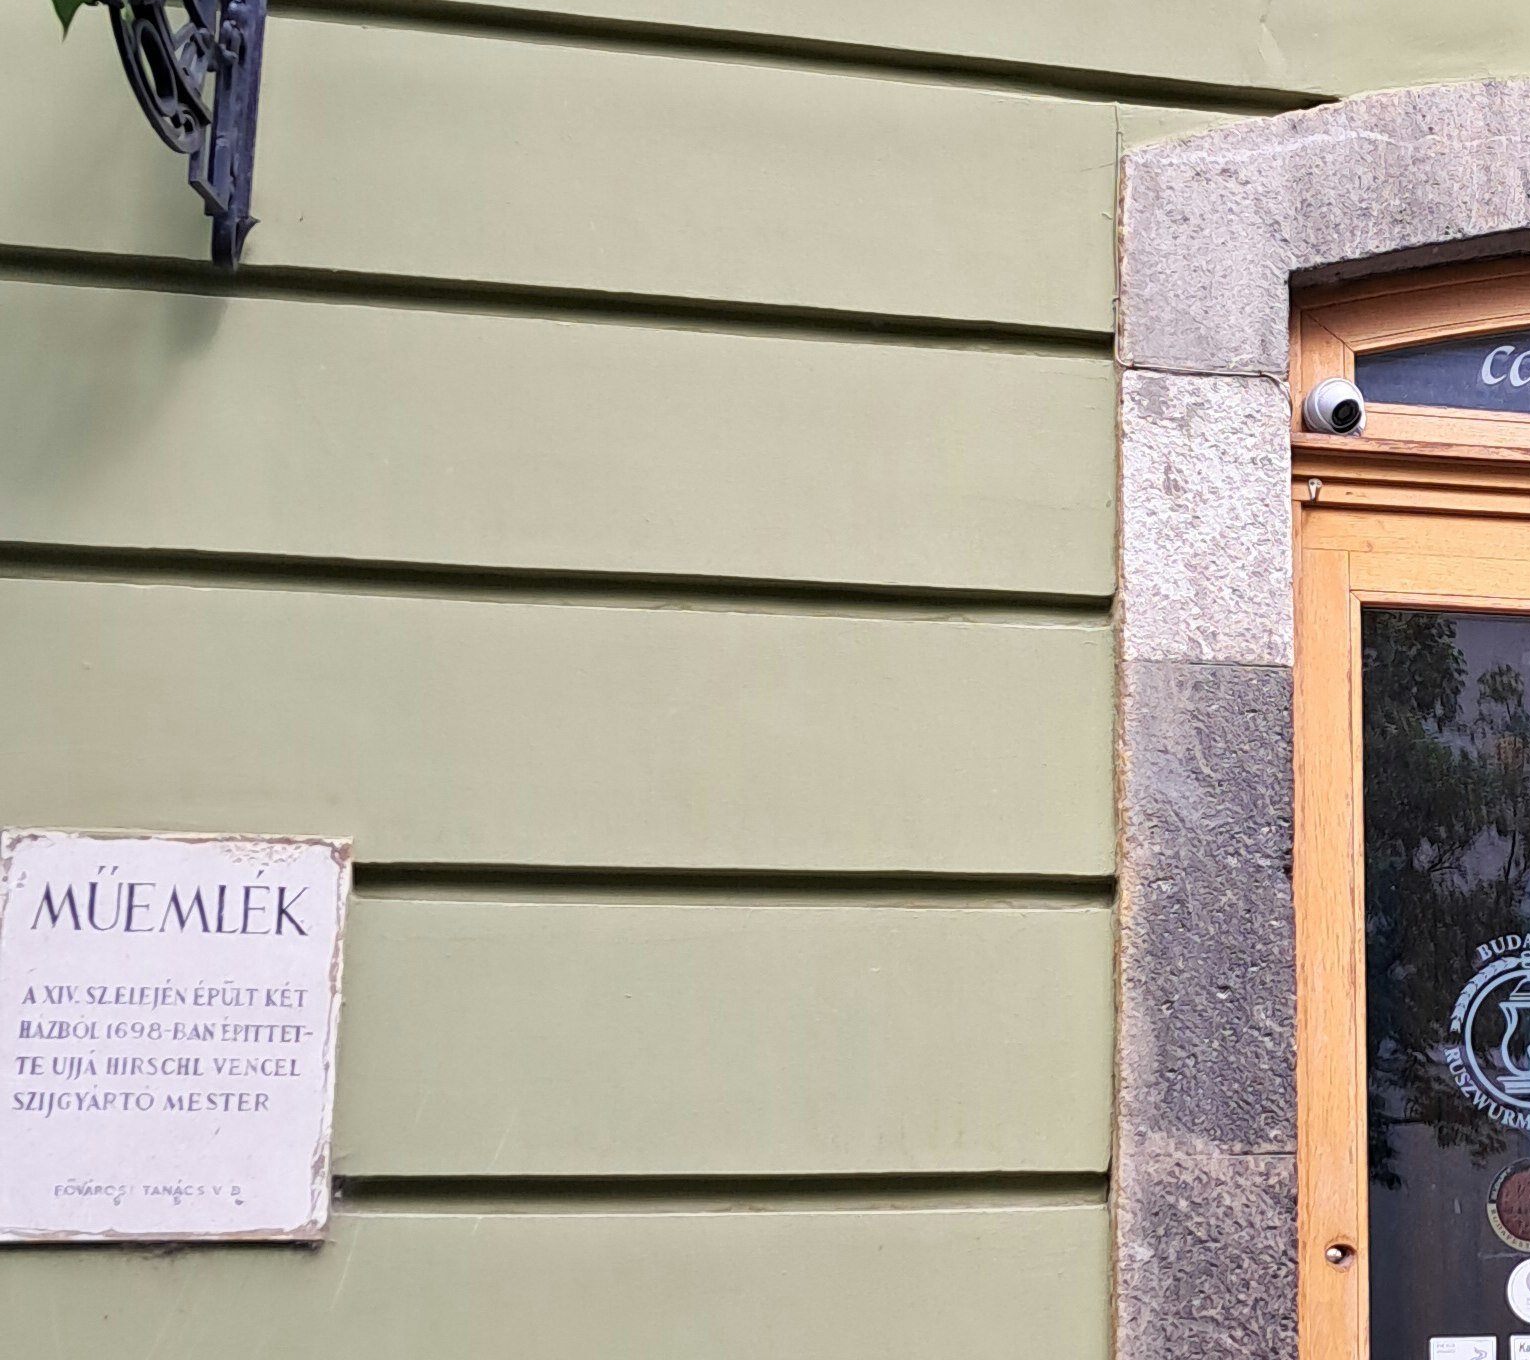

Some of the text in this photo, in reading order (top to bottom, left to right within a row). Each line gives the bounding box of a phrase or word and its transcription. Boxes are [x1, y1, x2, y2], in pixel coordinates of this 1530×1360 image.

[30, 866, 311, 937] MŰEMLÉK
[21, 986, 36, 1004] A
[264, 981, 308, 1007] KÉT
[106, 1021, 216, 1041] 1698-BAN
[15, 1049, 301, 1080] TE UJJÁ HIRSCHL VENCEL
[163, 1092, 269, 1112] MESTER
